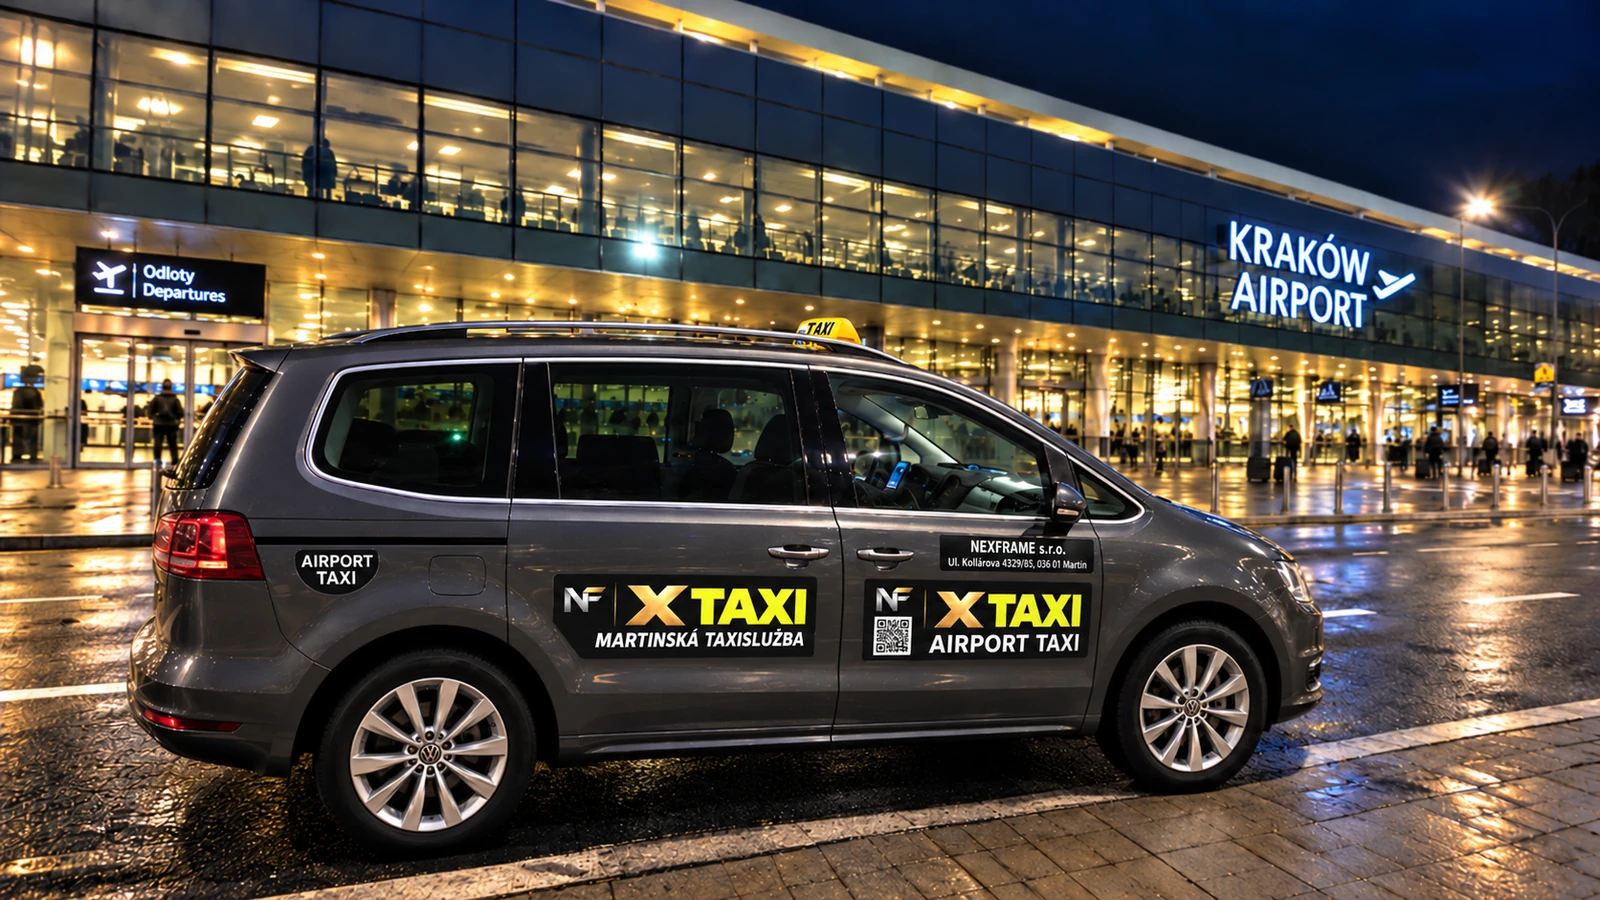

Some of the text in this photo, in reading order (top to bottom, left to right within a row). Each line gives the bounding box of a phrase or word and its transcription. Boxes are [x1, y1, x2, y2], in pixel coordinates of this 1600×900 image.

[1229, 220, 1370, 286] KRAKÓW
[143, 264, 195, 286] Odloty
[143, 282, 226, 303] Departures
[1230, 271, 1367, 328] AIRPORT
[807, 322, 835, 335] TAXI
[970, 539, 1066, 556] NEXFRAME s.r.o.
[301, 554, 374, 569] AIRPORT
[962, 557, 1000, 568] Kollárova
[1037, 560, 1051, 569] 036
[1052, 560, 1061, 569] 01
[1063, 560, 1087, 570] Martin
[316, 571, 356, 586] TAXI
[595, 628, 804, 649] MARTINSKÁ TAXISLUŽBA
[928, 634, 1080, 654] AIRPORT TAXI
